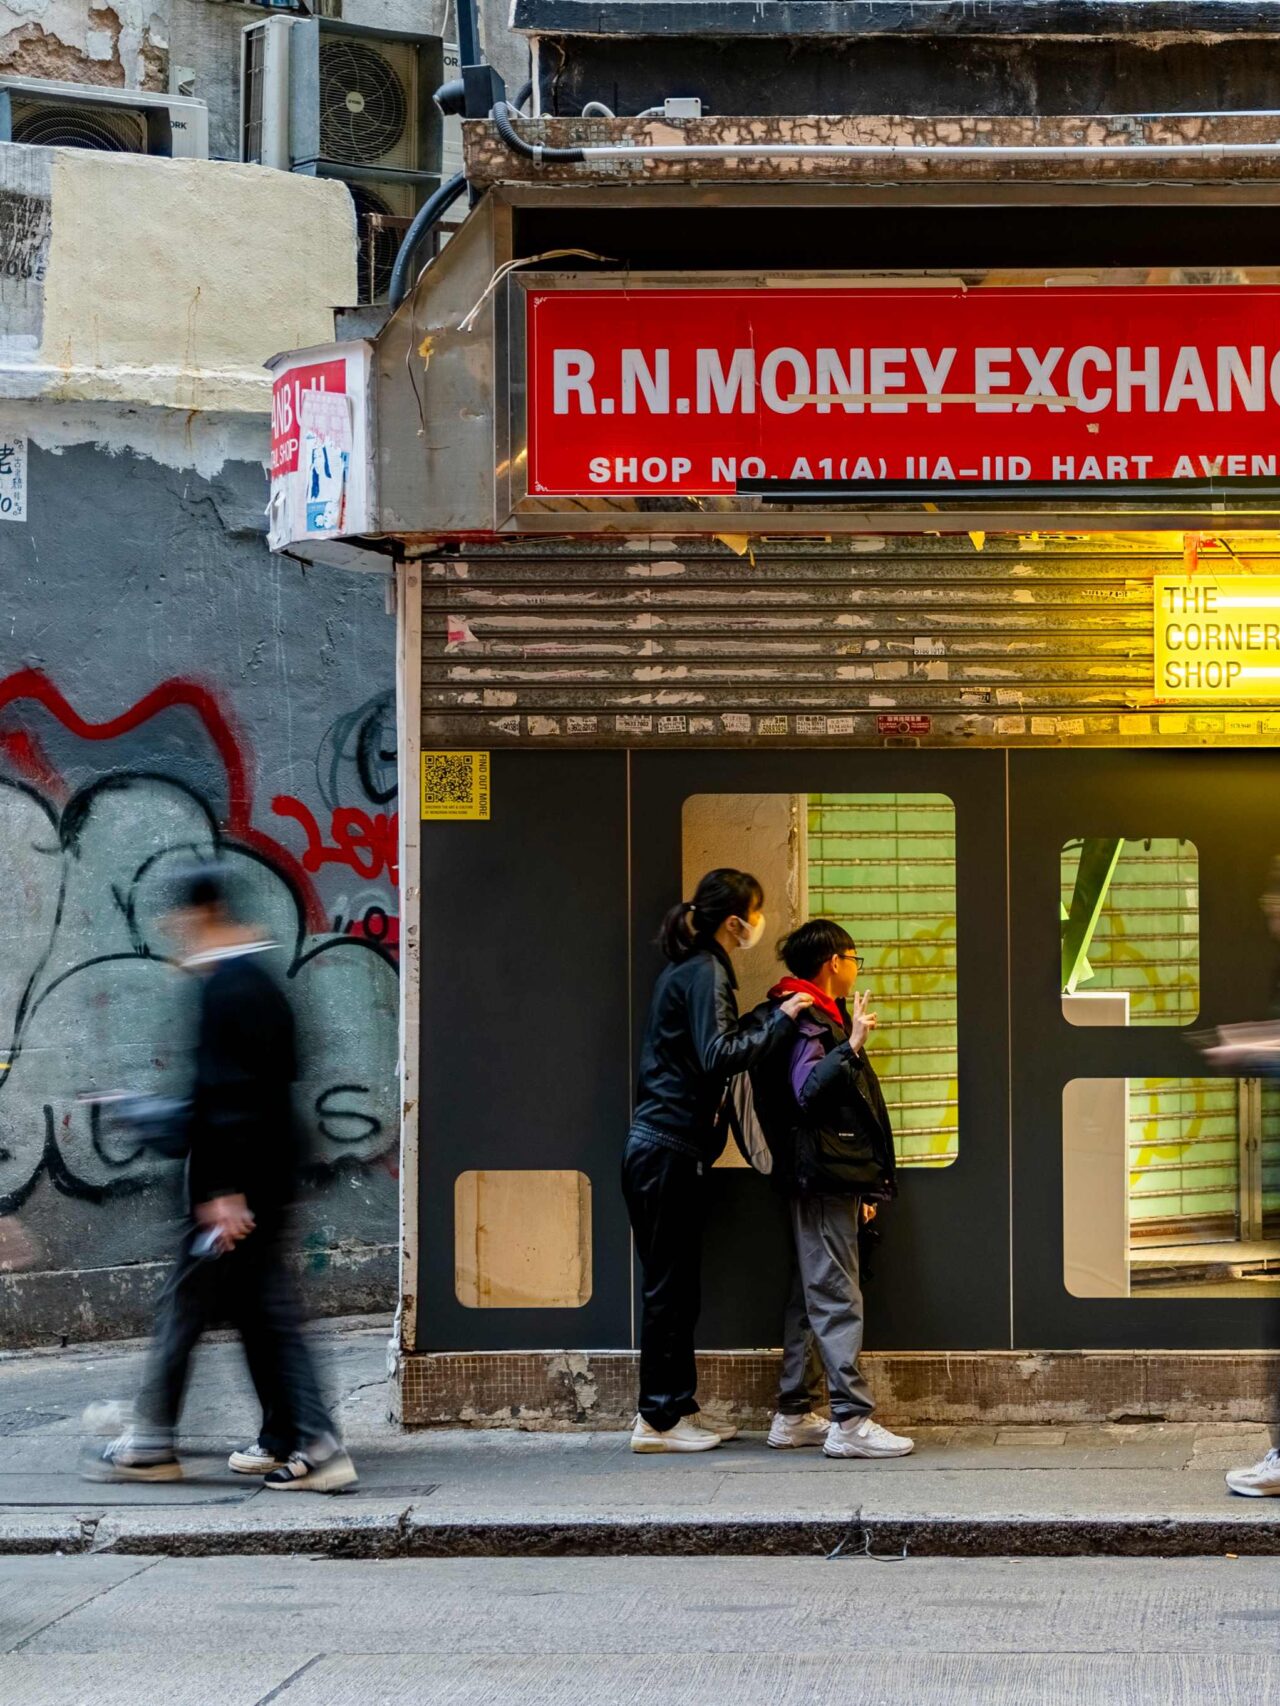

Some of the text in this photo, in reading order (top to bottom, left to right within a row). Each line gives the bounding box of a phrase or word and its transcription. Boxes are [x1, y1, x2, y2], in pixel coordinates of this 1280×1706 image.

[553, 347, 957, 415] R.N.MONEY
[589, 456, 692, 484] SHOP
[711, 457, 779, 482] NO.
[789, 456, 888, 480] A1(A)
[1052, 455, 1153, 480] HART
[1163, 586, 1218, 614] THE
[1165, 623, 1280, 651] CORNER
[1165, 660, 1242, 688] SHOP
[479, 754, 487, 816] FIND OUT MORE
